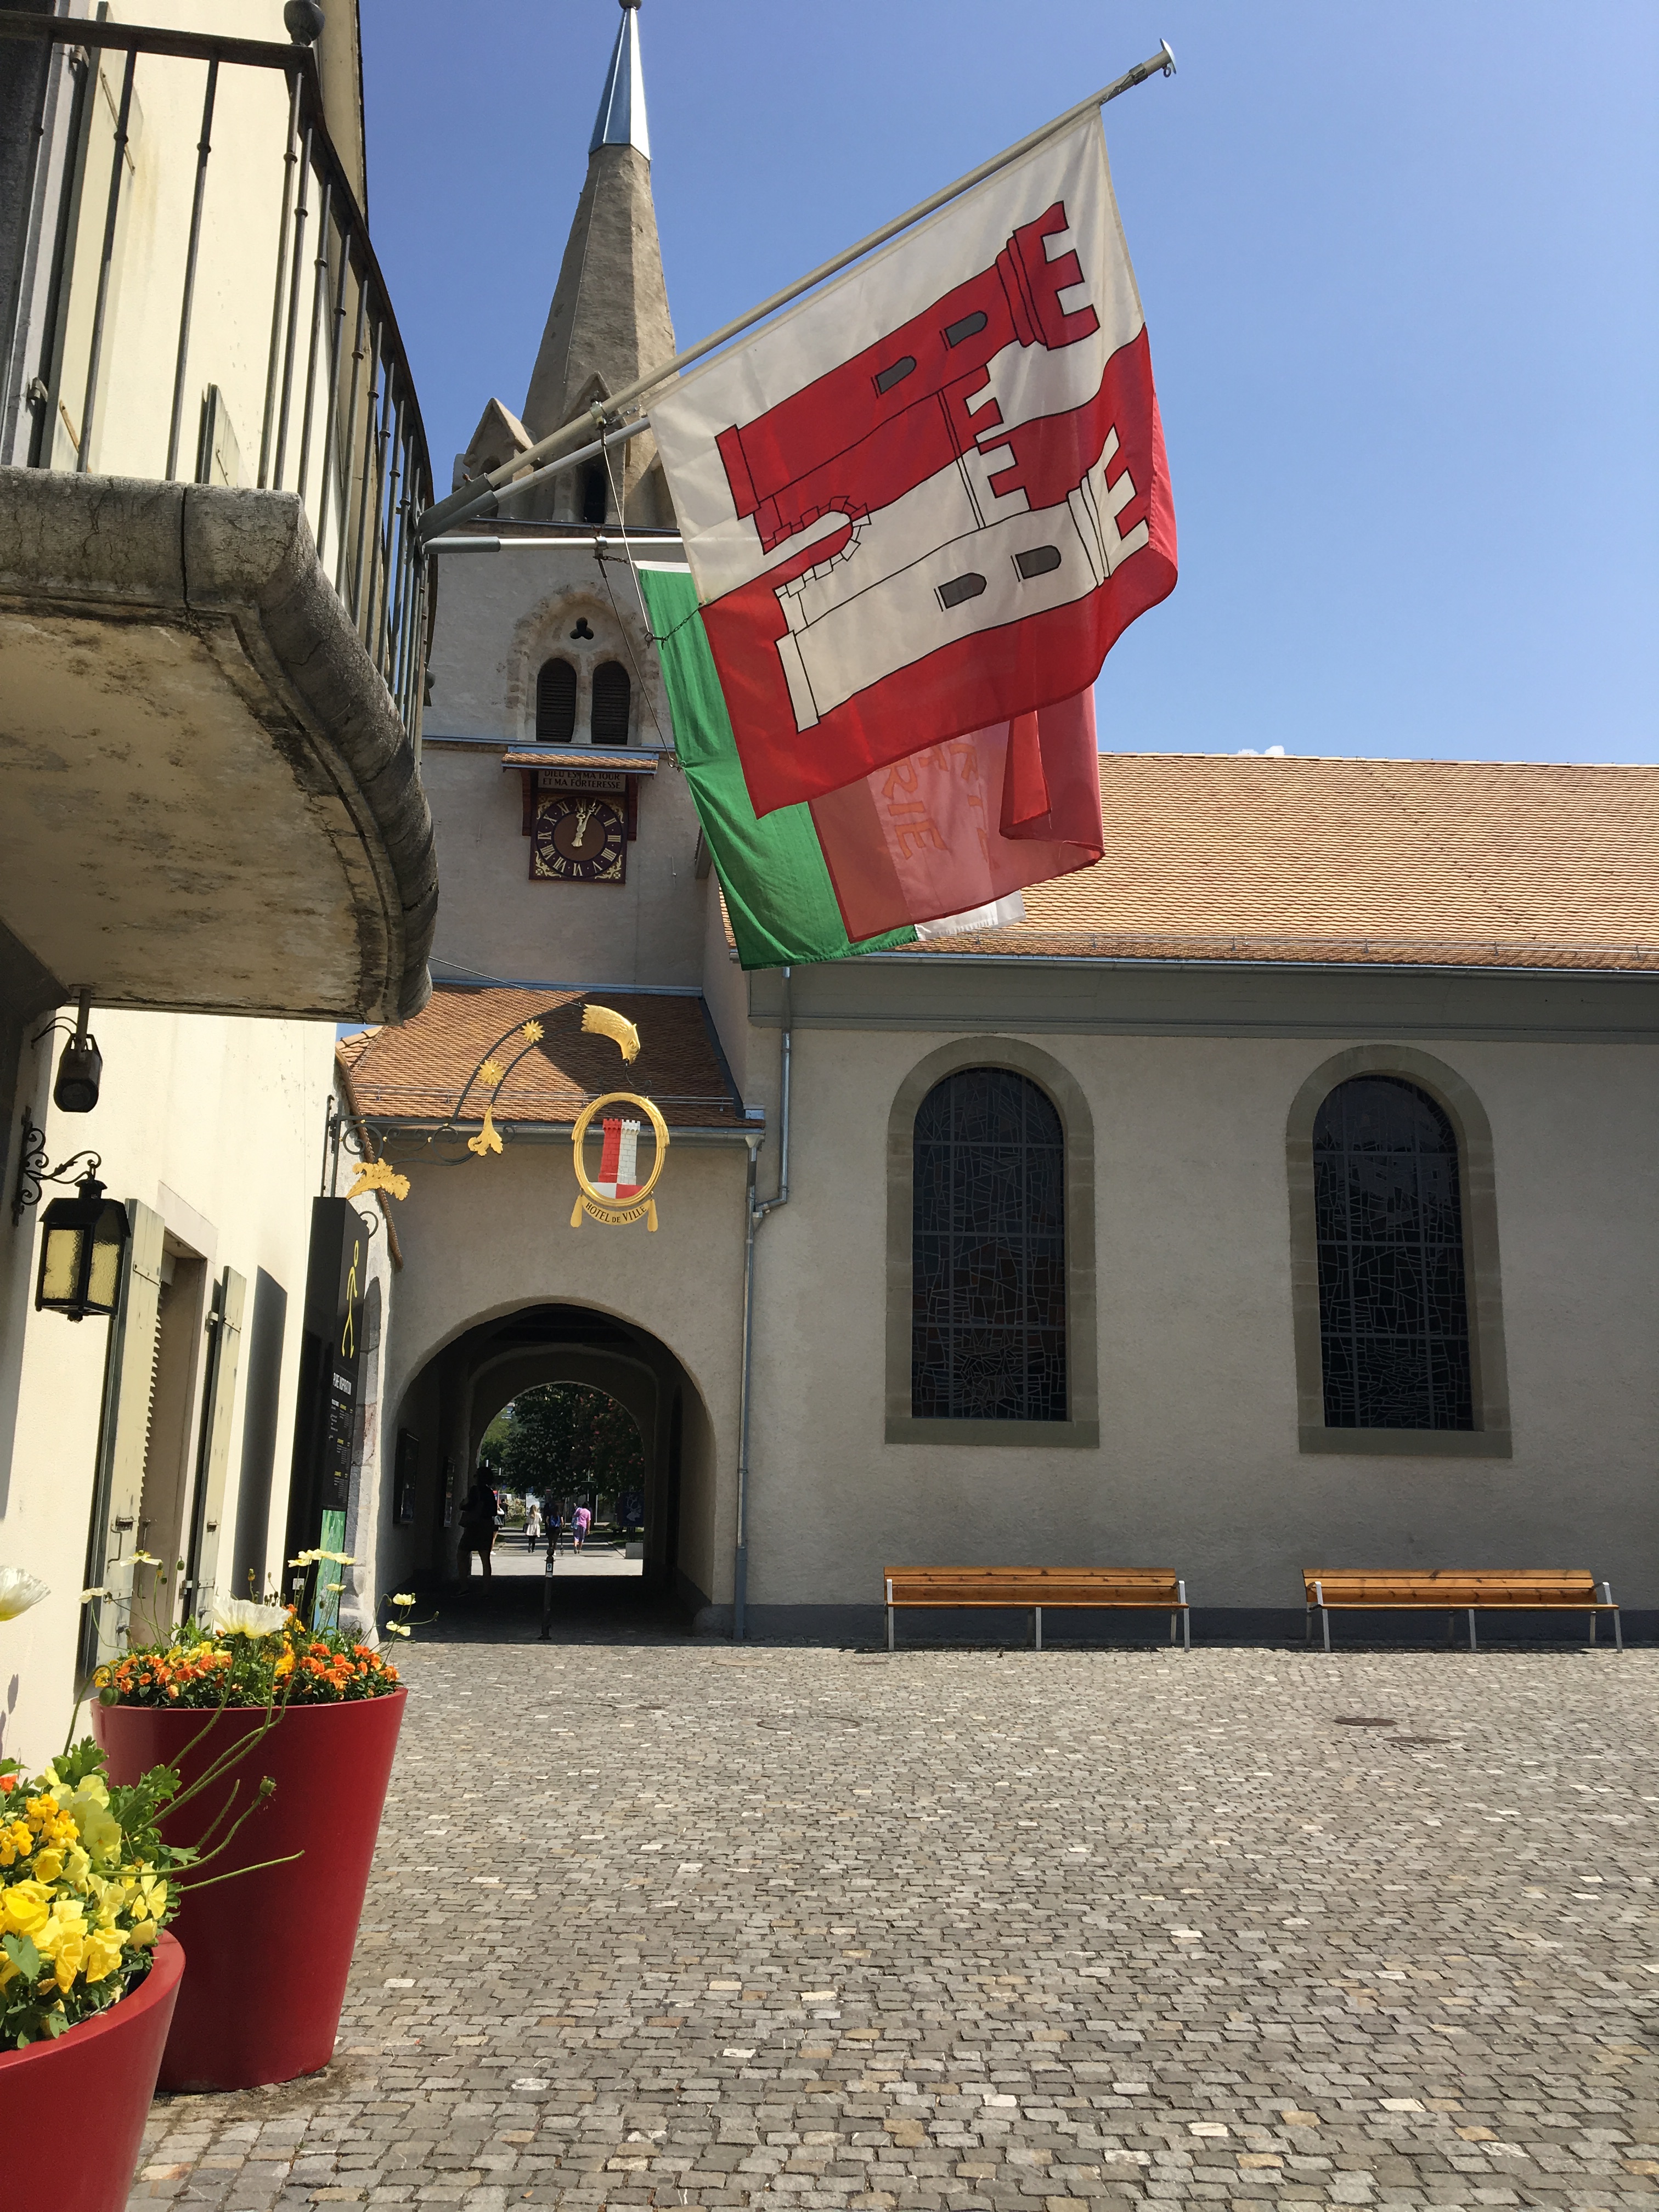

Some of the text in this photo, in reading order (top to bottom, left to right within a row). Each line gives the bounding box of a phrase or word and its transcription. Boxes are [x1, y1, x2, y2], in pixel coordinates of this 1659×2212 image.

[571, 779, 621, 789] FORTERESSE
[557, 800, 570, 816] XI
[574, 798, 586, 811] XII
[878, 757, 949, 860] RIE
[543, 813, 557, 826] X
[603, 817, 617, 827] II
[538, 831, 552, 840] IX
[607, 834, 621, 843] III
[540, 844, 555, 860] VIII
[601, 847, 617, 862] IIII
[552, 856, 567, 873] VII
[572, 862, 583, 877] VI
[592, 860, 603, 874] V
[586, 1202, 610, 1222] HOTEL
[622, 1205, 647, 1221] VILLE
